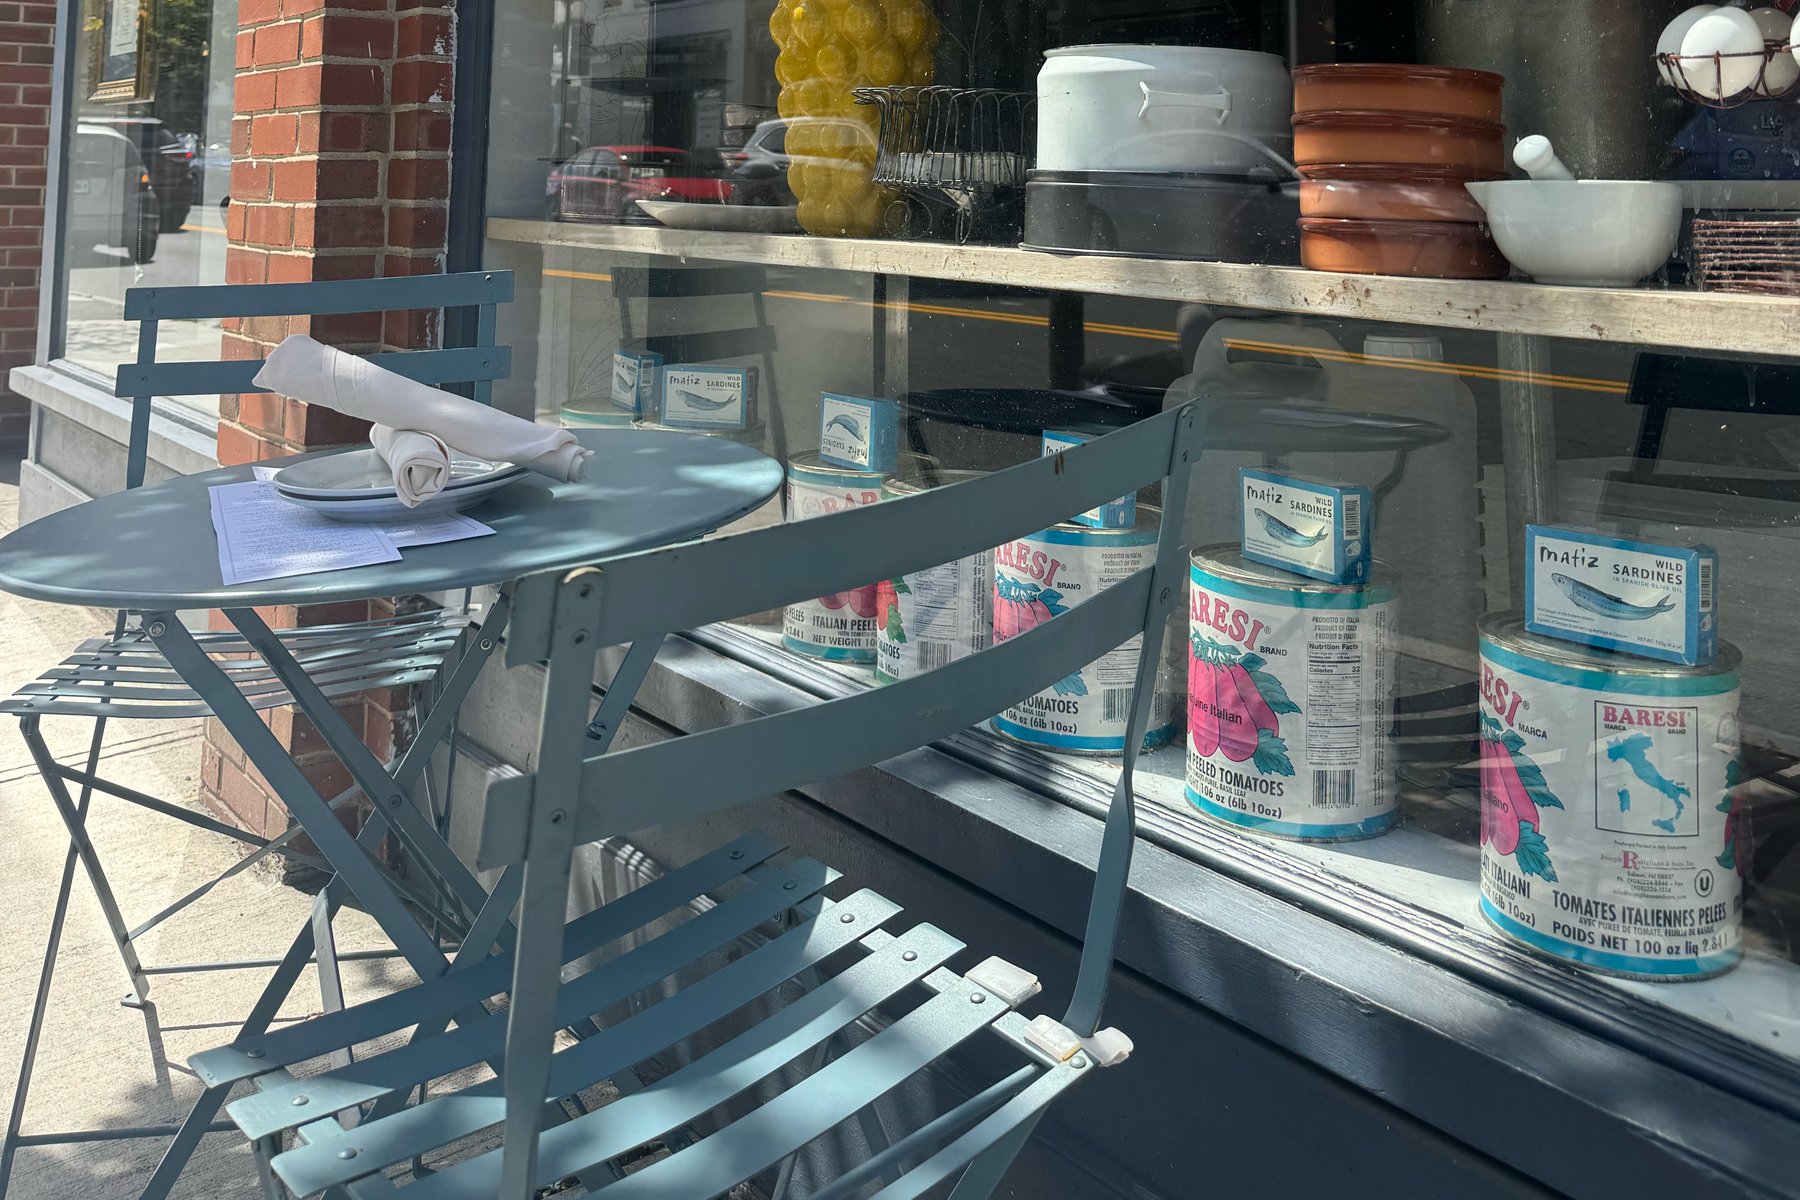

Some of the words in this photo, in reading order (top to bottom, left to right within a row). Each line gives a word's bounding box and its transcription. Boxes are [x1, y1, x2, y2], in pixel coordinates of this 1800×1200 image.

[670, 374, 700, 385] matiz
[706, 381, 740, 389] SARDINES
[1247, 485, 1283, 504] matiz
[1315, 496, 1332, 507] WILD
[1290, 500, 1332, 517] SARDINES
[1540, 546, 1599, 569] matiz
[1656, 559, 1683, 571] WILD
[1613, 564, 1683, 585] SARDINES
[1057, 582, 1081, 590] BRAND
[1622, 578, 1650, 588] SPANISH
[1651, 583, 1670, 592] OLIVE
[789, 607, 804, 622] PELEES
[813, 615, 847, 630] ITALIAN
[851, 620, 877, 631] PEELE
[1190, 589, 1264, 650] ARESI
[789, 627, 800, 639] 2.84
[813, 634, 826, 644] NET
[829, 636, 862, 647] WEIGHT
[866, 638, 877, 646] 10
[1260, 646, 1287, 656] BRAND
[1023, 708, 1034, 716] BASIL
[1210, 705, 1242, 724] Italian
[1603, 705, 1686, 728] BARESI
[1006, 710, 1017, 721] 106
[1019, 716, 1027, 724] oz
[1030, 716, 1047, 729] (6lb
[1051, 721, 1077, 734] 10oz)
[1604, 723, 1627, 732] MARCA
[1518, 722, 1548, 740] MARCA
[1192, 753, 1216, 778] PEELED
[1219, 767, 1284, 797] TOMATOES
[1220, 784, 1233, 794] BASIL
[1234, 789, 1247, 798] LEAF
[1201, 783, 1213, 798] 106
[1216, 794, 1225, 803] oz
[1228, 795, 1247, 810] (6lb
[1252, 802, 1282, 819] 10oz)
[1491, 858, 1530, 899] ITALIANI
[1493, 889, 1505, 910] (6lb
[1509, 901, 1535, 927] 10oz)
[1553, 890, 1617, 922] TOMATES
[1622, 906, 1695, 927] ITALIENNES
[1699, 902, 1726, 925] PELEES
[1578, 917, 1596, 927] AVEC
[1598, 921, 1620, 933] PUREE
[1622, 926, 1631, 934] DE
[1633, 927, 1663, 936] TOMATE,
[1553, 921, 1595, 945] POIDS
[1601, 934, 1628, 951] NET
[1635, 940, 1662, 954] 100
[1666, 944, 1681, 954] oz
[1685, 940, 1699, 957] liq
